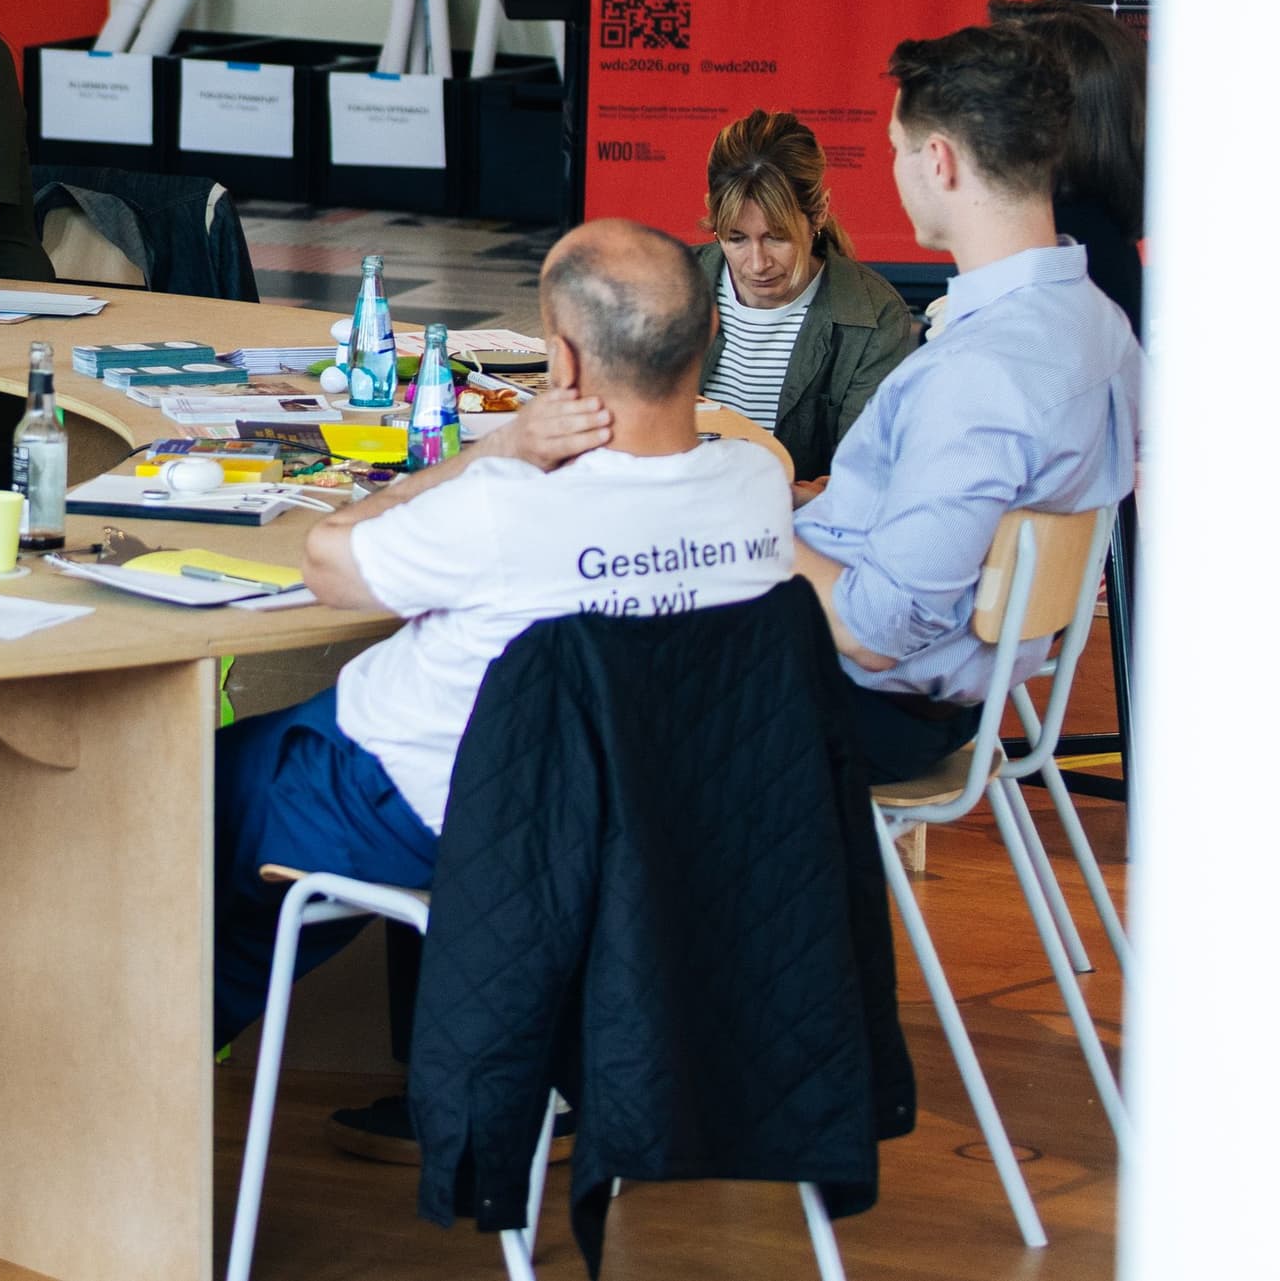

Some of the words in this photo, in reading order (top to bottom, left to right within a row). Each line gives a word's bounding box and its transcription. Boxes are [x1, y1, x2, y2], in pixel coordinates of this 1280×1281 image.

[600, 59, 690, 74] wdc2026.org
[701, 60, 777, 73] @wdc2026
[598, 141, 632, 161] WDO
[578, 537, 736, 579] Gestalten
[579, 590, 640, 616] wie
[653, 582, 698, 615] wir
